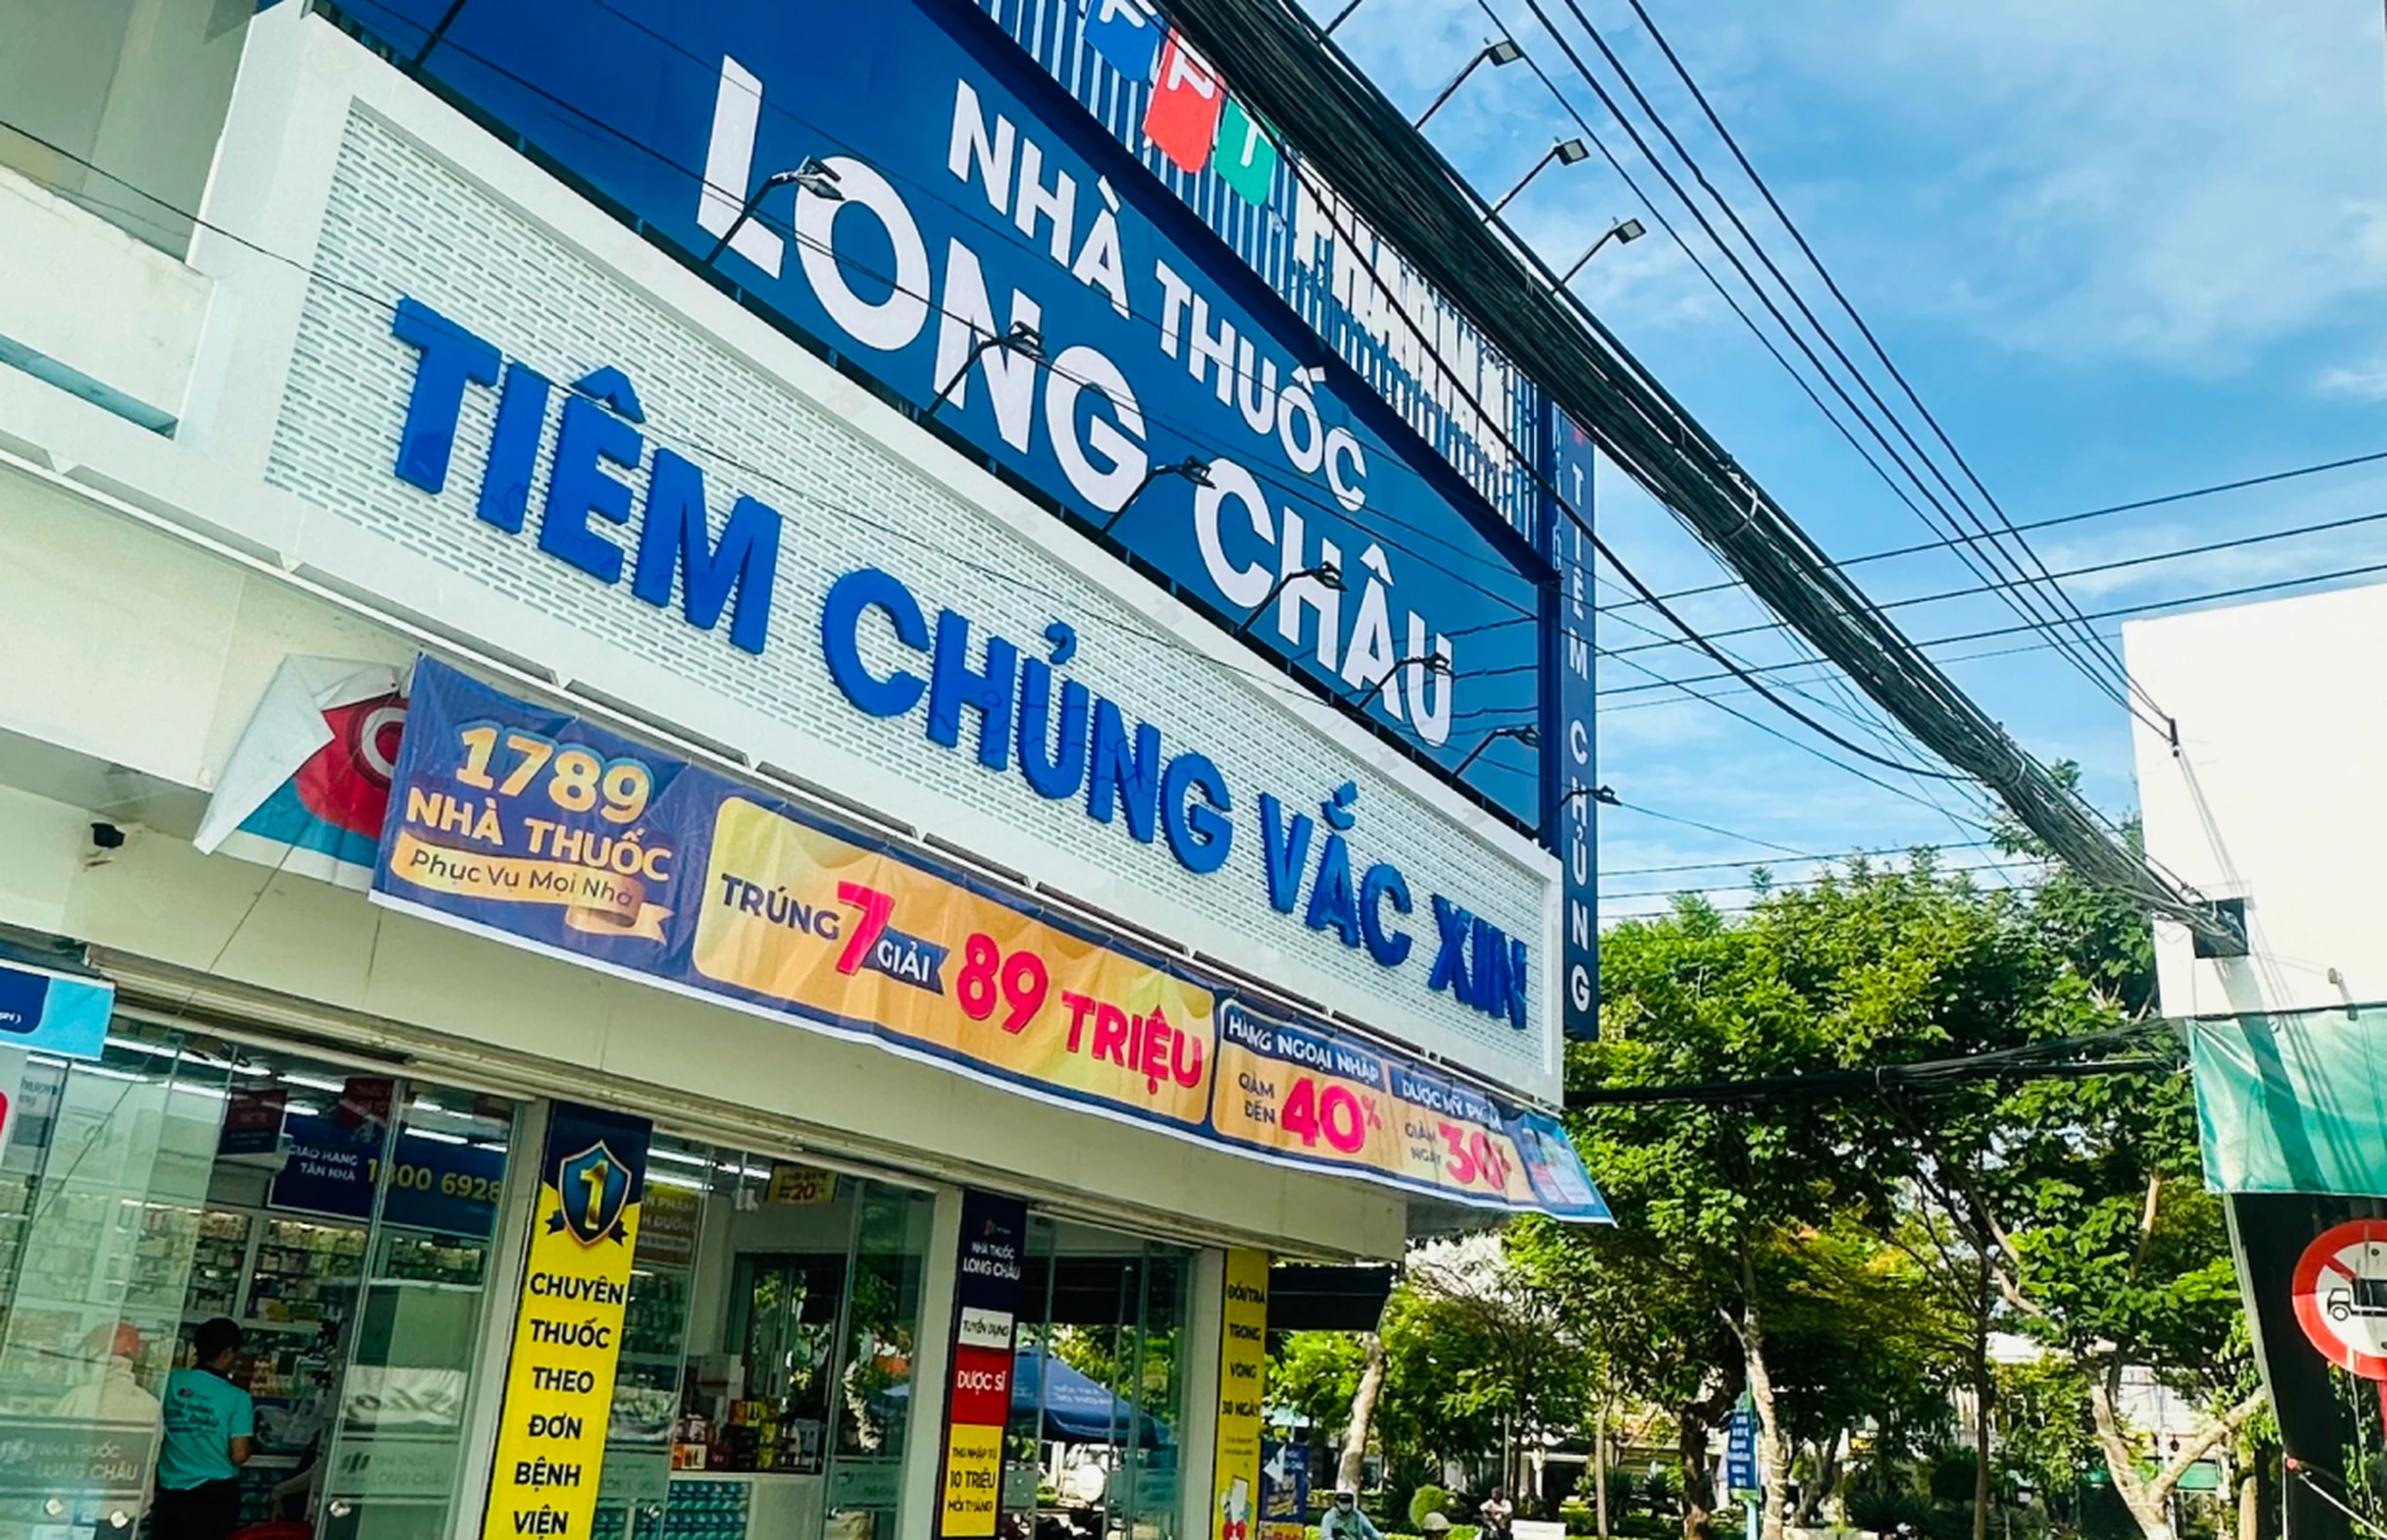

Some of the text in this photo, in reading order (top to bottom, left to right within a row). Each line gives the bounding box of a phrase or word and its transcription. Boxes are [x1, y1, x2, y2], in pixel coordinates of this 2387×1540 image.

[947, 77, 1132, 320] NHÀ
[1154, 259, 1367, 512] THUỐC
[697, 54, 1148, 513] LONG
[1194, 458, 1452, 748] CHÂU
[393, 294, 1527, 1029] TIÊM CHỦNG VẮC XIN
[1568, 461, 1590, 1012] TIÊM CHỦNG
[456, 725, 652, 825] 1789
[406, 788, 672, 882] NHÀ THUỐC
[410, 848, 633, 908] Phục Vụ Mọi Nhà
[722, 873, 1203, 1095] TRÚNG 7 GIẢI 89 TRIỆU
[1229, 1014, 1379, 1084] HÀNG NGOẠI NHẬP
[1244, 1100, 1276, 1124] ĐẾN
[1281, 1076, 1382, 1154] 40%
[579, 1159, 609, 1231] 1
[530, 1272, 625, 1305] CHUYÊN
[963, 1257, 1021, 1281] LONG CHÂU
[531, 1317, 611, 1349] THUỐC
[532, 1367, 594, 1394] THEO
[958, 1370, 993, 1396] DƯỢC
[528, 1411, 582, 1440] ĐƠN
[90, 1460, 138, 1480] CHÂU
[515, 1457, 580, 1492] BỆNH
[950, 1467, 996, 1493] 10 TRIỆU
[513, 1505, 568, 1540] VIỆN
